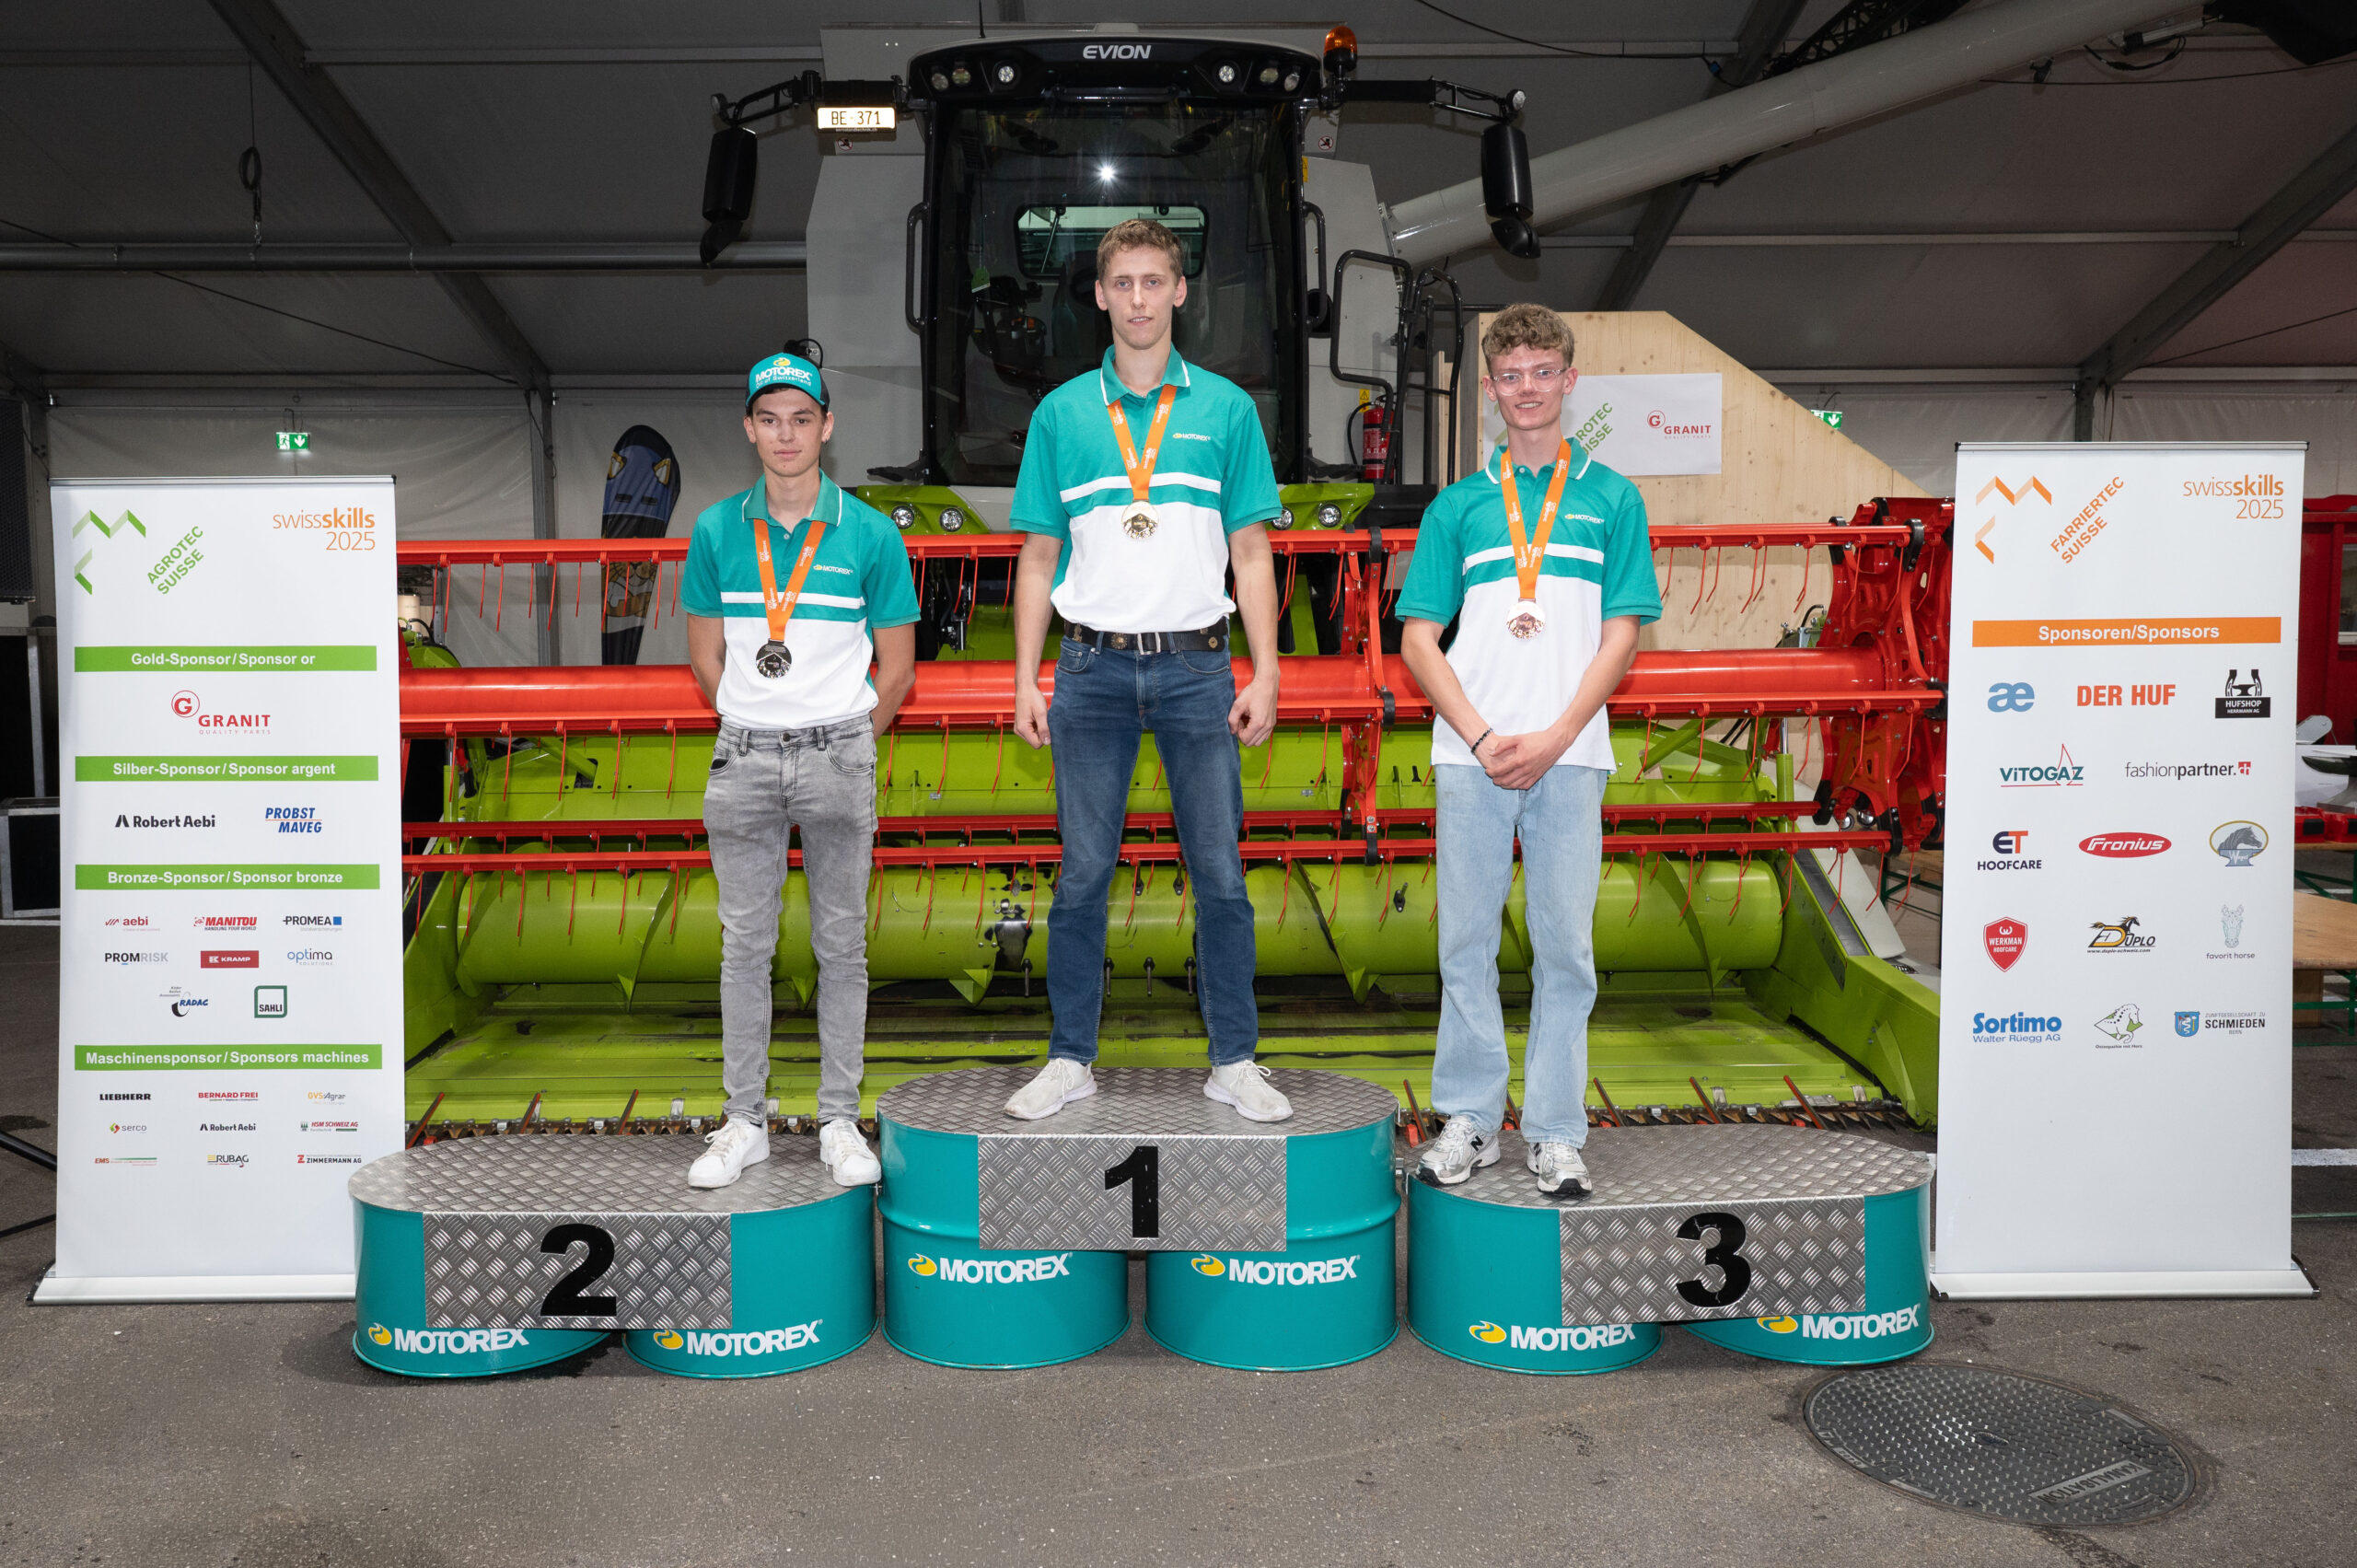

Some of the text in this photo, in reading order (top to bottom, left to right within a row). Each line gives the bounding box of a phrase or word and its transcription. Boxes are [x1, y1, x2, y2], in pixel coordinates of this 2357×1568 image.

[1083, 45, 1152, 59] EVION
[831, 110, 881, 125] BE 371
[756, 366, 811, 383] MOTOREX
[772, 375, 811, 387] Switzerland
[1575, 402, 1613, 441] ROTEC
[1664, 424, 1712, 435] GRANIT
[1583, 423, 1613, 455] ISSE
[2183, 474, 2284, 497] swissskills
[2050, 476, 2124, 553] FARRIERTEC
[2235, 499, 2284, 519] 2025
[273, 507, 376, 529] swissskills
[326, 531, 376, 551] 2025
[2061, 517, 2107, 564] SUISSE
[146, 526, 203, 585] AGROTEC
[157, 549, 204, 595] SUISSE
[822, 565, 851, 575] MOTOREX
[2038, 624, 2220, 644] Sponsoren/Sponsors
[300, 655, 316, 665] or
[2076, 684, 2176, 707] DER HUF
[2225, 700, 2262, 708] HUFSHOP
[198, 714, 271, 727] GRANIT
[292, 762, 336, 777] argent
[265, 807, 315, 819] PROBST
[134, 815, 215, 828] Robert Aebi
[279, 821, 322, 833] MAVEG
[1992, 830, 2028, 854] ET
[2087, 836, 2165, 852] Fronius
[1977, 859, 2042, 871] HOOFCARE
[296, 871, 343, 884] bronze
[122, 916, 148, 926] aebi
[204, 917, 257, 926] MANITOU
[284, 916, 331, 925] PROMEA
[1989, 937, 2023, 947] WERKMAN
[104, 952, 168, 962] PROMRISK
[287, 948, 332, 963] optima
[1973, 1012, 2062, 1034] Sortimo
[2205, 1018, 2266, 1029] SCHMIEDEN
[1973, 1033, 2061, 1044] Walter Rüegg AG
[303, 1051, 369, 1063] machines
[1105, 1146, 1158, 1237] 1
[942, 1253, 1070, 1283] MOTOREX
[1676, 1212, 1750, 1308] 3
[540, 1224, 617, 1317] 2
[1229, 1255, 1358, 1285] MOTOREX
[1803, 1307, 1919, 1340] MOTOREX
[394, 1327, 529, 1354] MOTOREX
[687, 1322, 820, 1357] MOTOREX
[1511, 1323, 1636, 1351] MOTOREX
